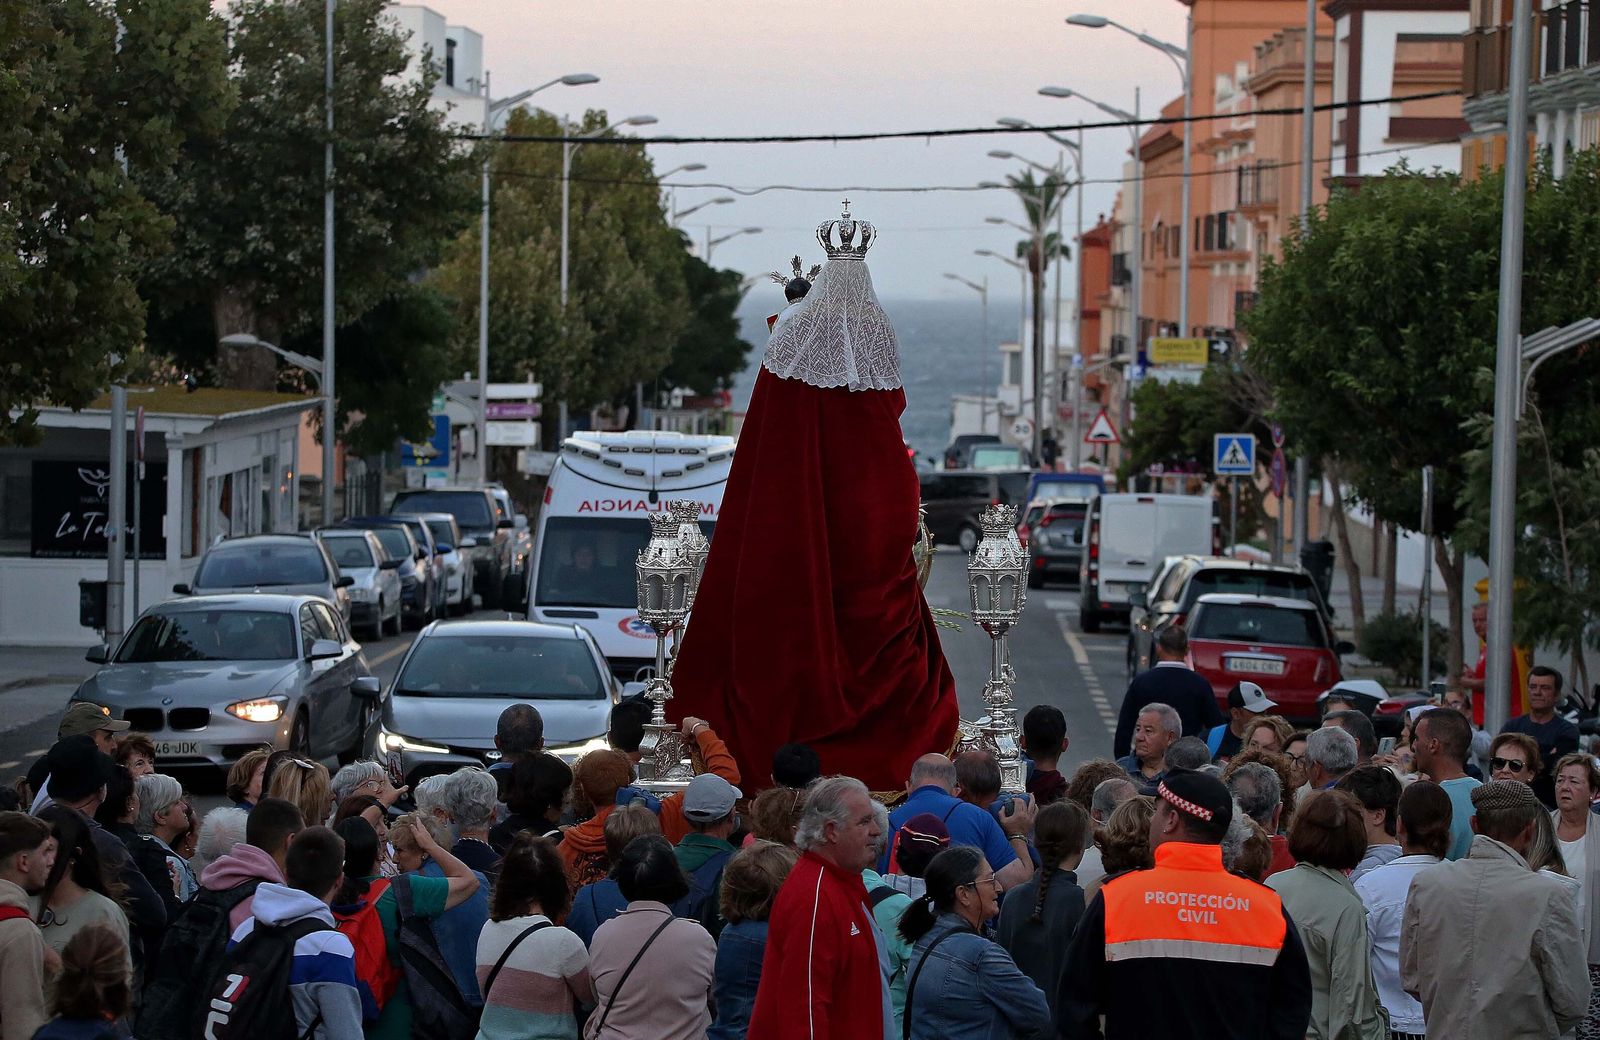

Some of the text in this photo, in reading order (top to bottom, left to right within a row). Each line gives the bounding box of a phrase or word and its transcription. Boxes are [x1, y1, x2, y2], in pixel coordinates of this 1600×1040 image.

[55, 511, 78, 539] La
[174, 742, 198, 754] JDK
[1144, 891, 1250, 911] PROTECCIÓN
[1177, 908, 1218, 924] CIVIL
